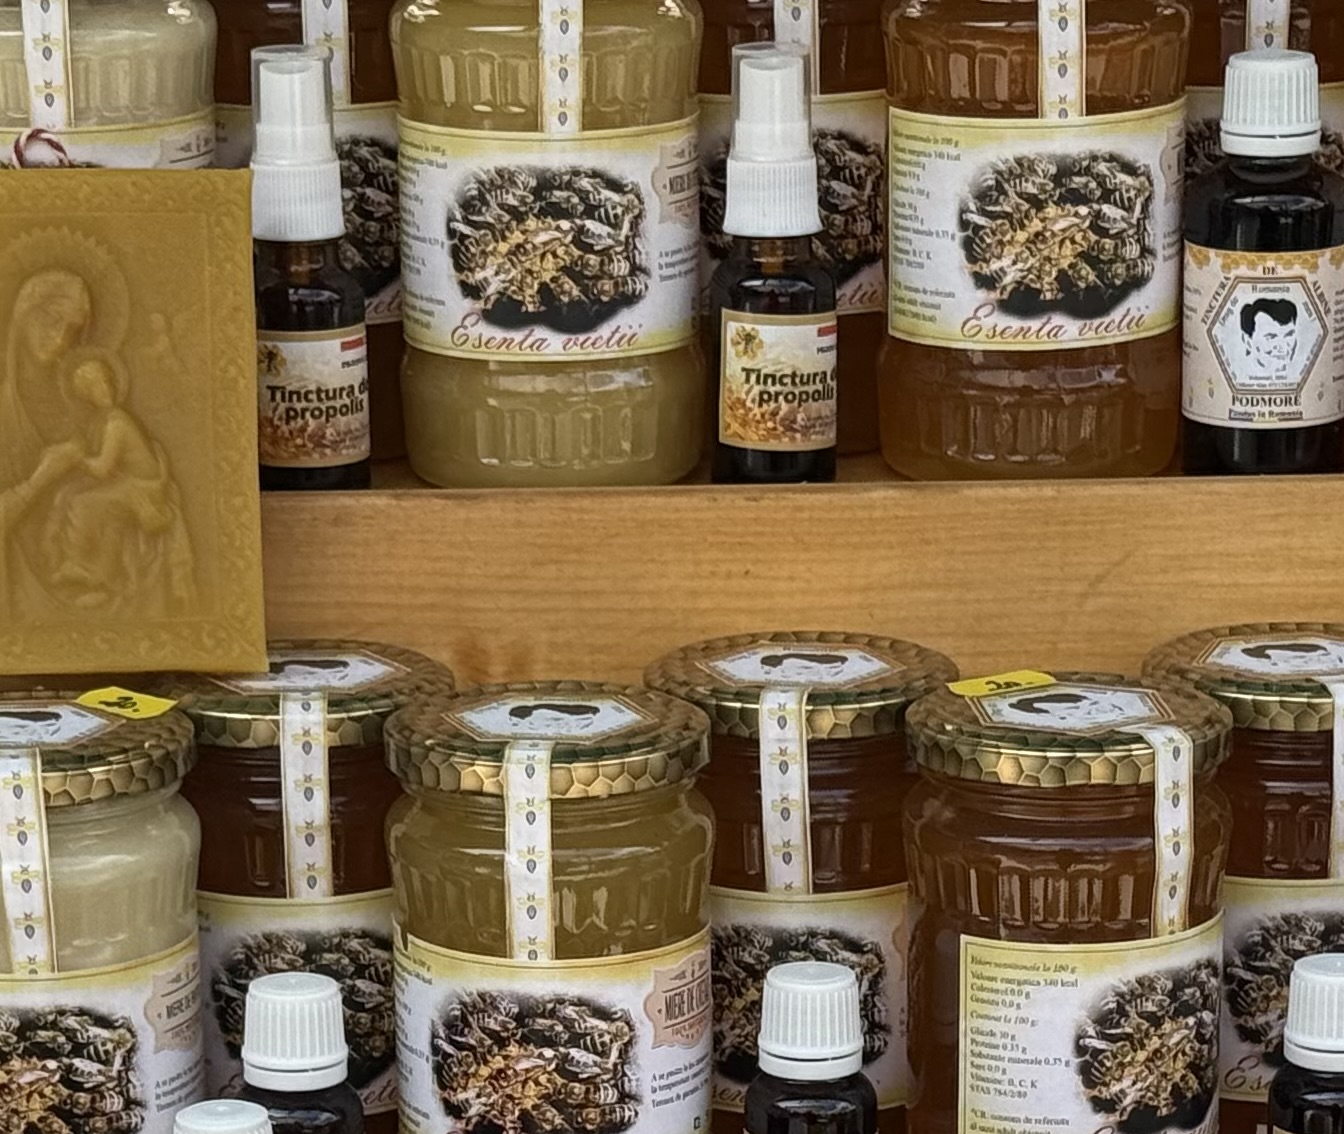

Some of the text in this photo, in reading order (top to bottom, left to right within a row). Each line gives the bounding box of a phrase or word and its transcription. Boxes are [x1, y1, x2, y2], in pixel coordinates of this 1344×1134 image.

[451, 313, 549, 353] Esenta
[960, 303, 1067, 341] Esenta
[741, 366, 826, 388] Tinctura
[267, 385, 354, 406] Tinctura
[1231, 395, 1302, 408] PODMORE
[285, 398, 364, 423] propolis
